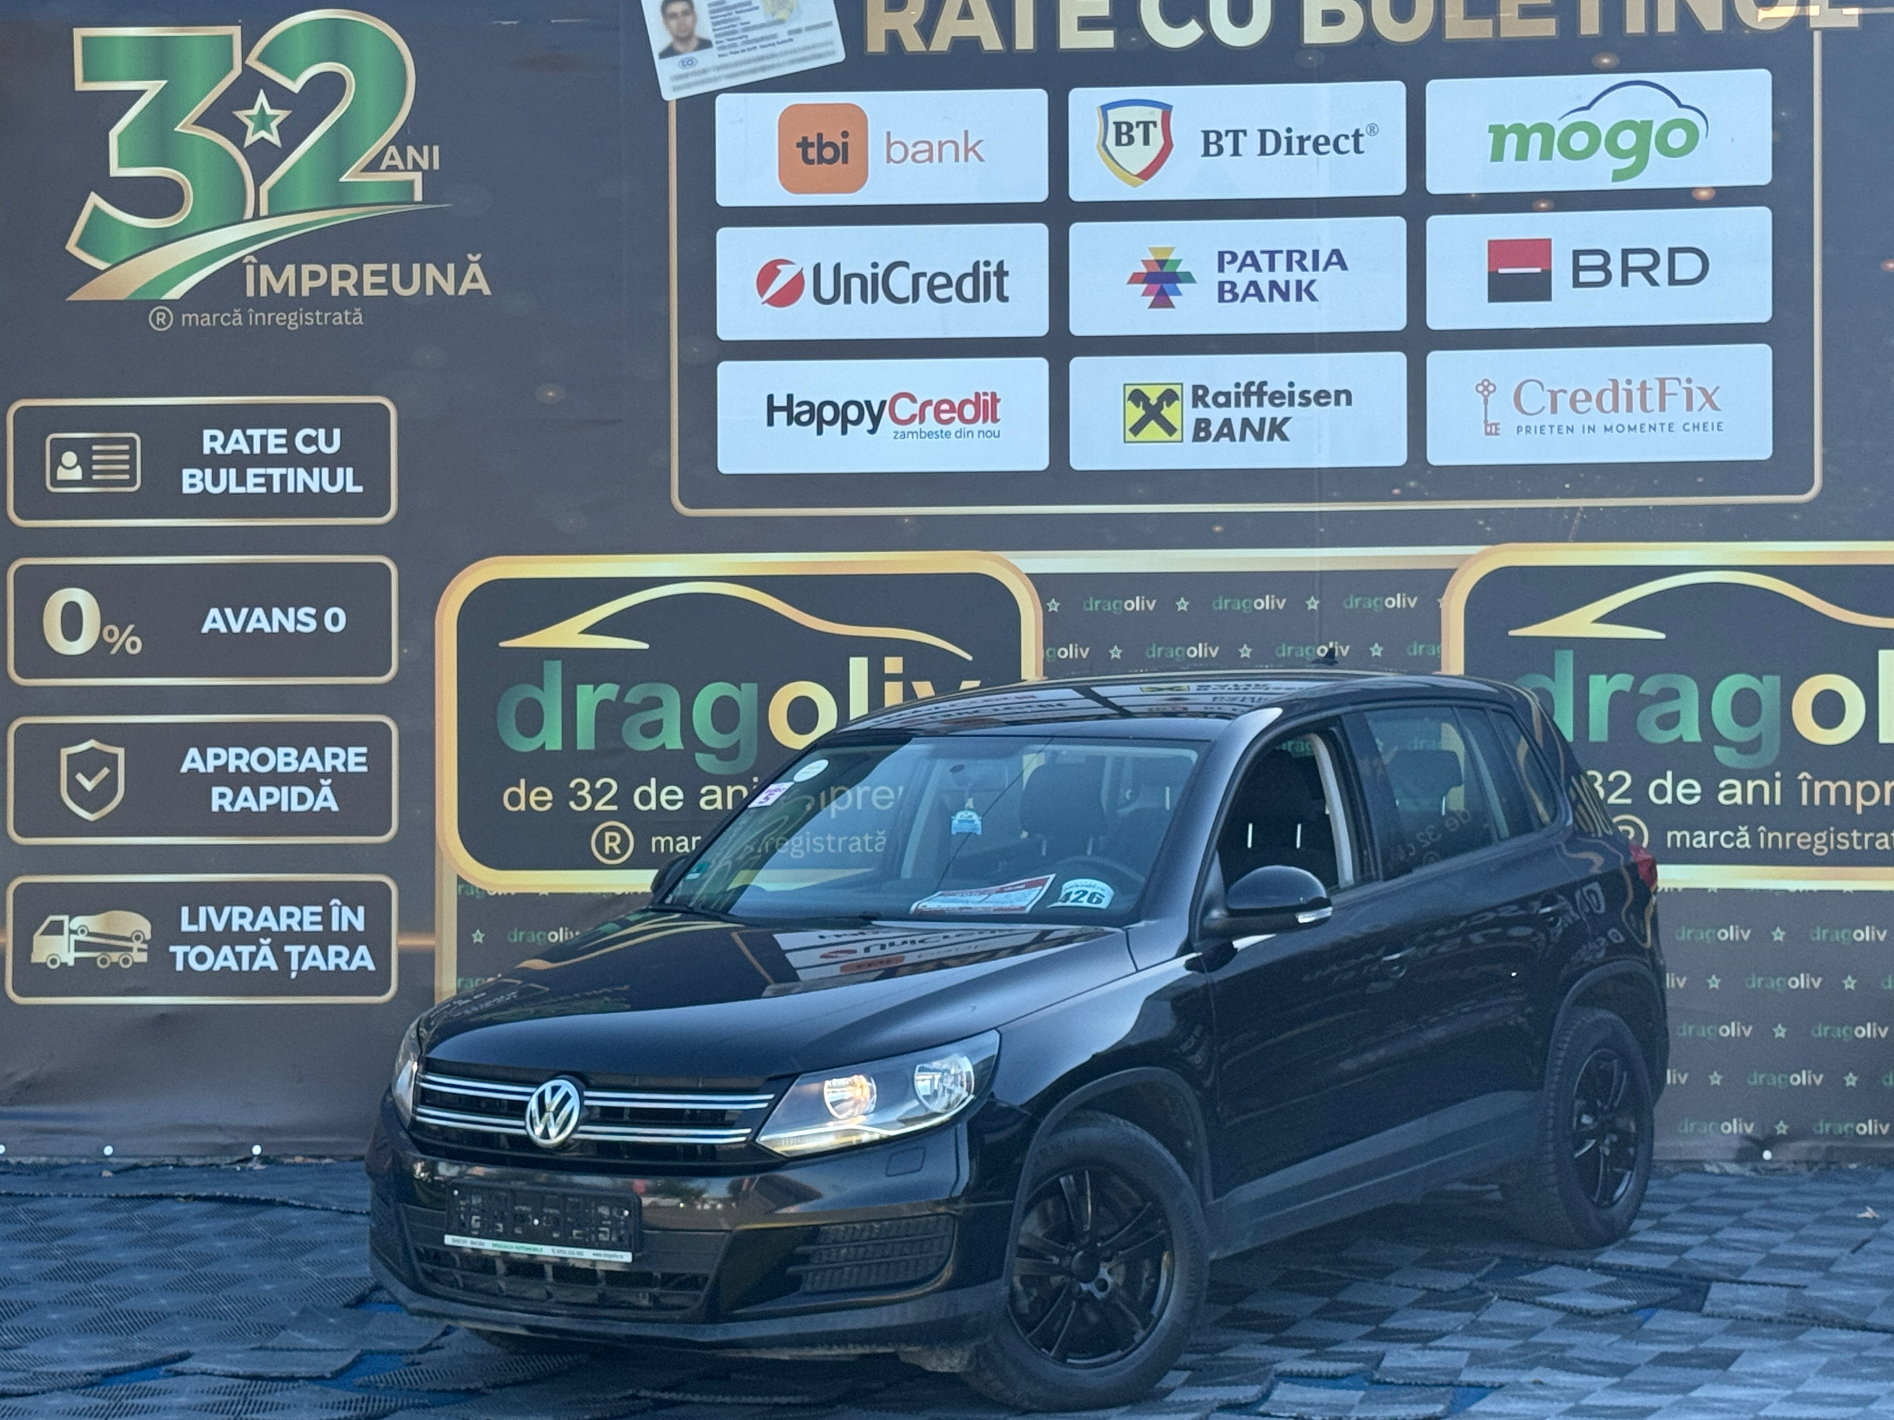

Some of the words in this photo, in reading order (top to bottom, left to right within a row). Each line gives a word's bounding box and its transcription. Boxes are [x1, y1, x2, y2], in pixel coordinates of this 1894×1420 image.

[1140, 0, 1272, 49] CU
[66, 8, 422, 270] 32
[1113, 120, 1157, 147] BT
[1201, 129, 1247, 158] BT
[380, 145, 440, 171] ANI
[796, 131, 849, 165] tbi
[885, 131, 985, 164] bank
[1488, 117, 1700, 182] mogo
[1217, 248, 1349, 273] PATRIA
[1572, 246, 1710, 289] BRD
[243, 253, 492, 298] ÎMPREUNĂ
[812, 259, 1009, 305] UniCredit
[1217, 279, 1320, 304] BANK
[181, 307, 243, 328] marcă
[248, 307, 364, 330] înregistrată
[1191, 380, 1353, 410] Raiffeisen
[1513, 376, 1722, 416] CreditFix
[766, 391, 1001, 436] HappyCredit
[202, 428, 288, 455] RATE
[294, 427, 342, 454] CU
[893, 427, 951, 441] zambeste
[954, 426, 975, 440] din
[977, 429, 1001, 440] nou
[1191, 417, 1293, 443] BANK
[1516, 424, 1576, 436] PRIETEN
[1582, 424, 1597, 435] IN
[1603, 422, 1676, 434] MOMENTE
[1682, 421, 1724, 433] CHEIE
[181, 467, 364, 495] BULETINUL
[1083, 595, 1157, 614] dragoliv
[1212, 595, 1286, 613] dragoliv
[1343, 593, 1418, 612] dragoliv
[201, 607, 318, 634] AVANS
[324, 607, 347, 632] 0
[1145, 642, 1219, 661] dragoliv
[496, 656, 981, 775] dragoli
[180, 747, 369, 773] APROBARE
[210, 778, 340, 814] RAPIDĂ
[502, 778, 553, 813] de
[568, 778, 619, 812] 32
[633, 777, 685, 811] de
[699, 776, 758, 811] an
[1648, 770, 1702, 805] de
[1717, 771, 1782, 806] ani
[651, 835, 702, 853] mar
[1667, 825, 1751, 849] marcă
[180, 905, 323, 933] LIVRARE
[329, 898, 365, 932] ÎN
[1675, 924, 1751, 945] dragoliv
[1810, 924, 1887, 945] dragoliv
[169, 937, 279, 972] TOATĂ
[284, 945, 376, 978] ȚARA
[1745, 973, 1822, 993] dragoliv
[1677, 1021, 1753, 1041] dragoliv
[1812, 1022, 1889, 1041] dragoliv
[1746, 1069, 1824, 1089] dragoliv
[1679, 1117, 1755, 1137] dragoliv
[1813, 1118, 1890, 1138] dragoliv
